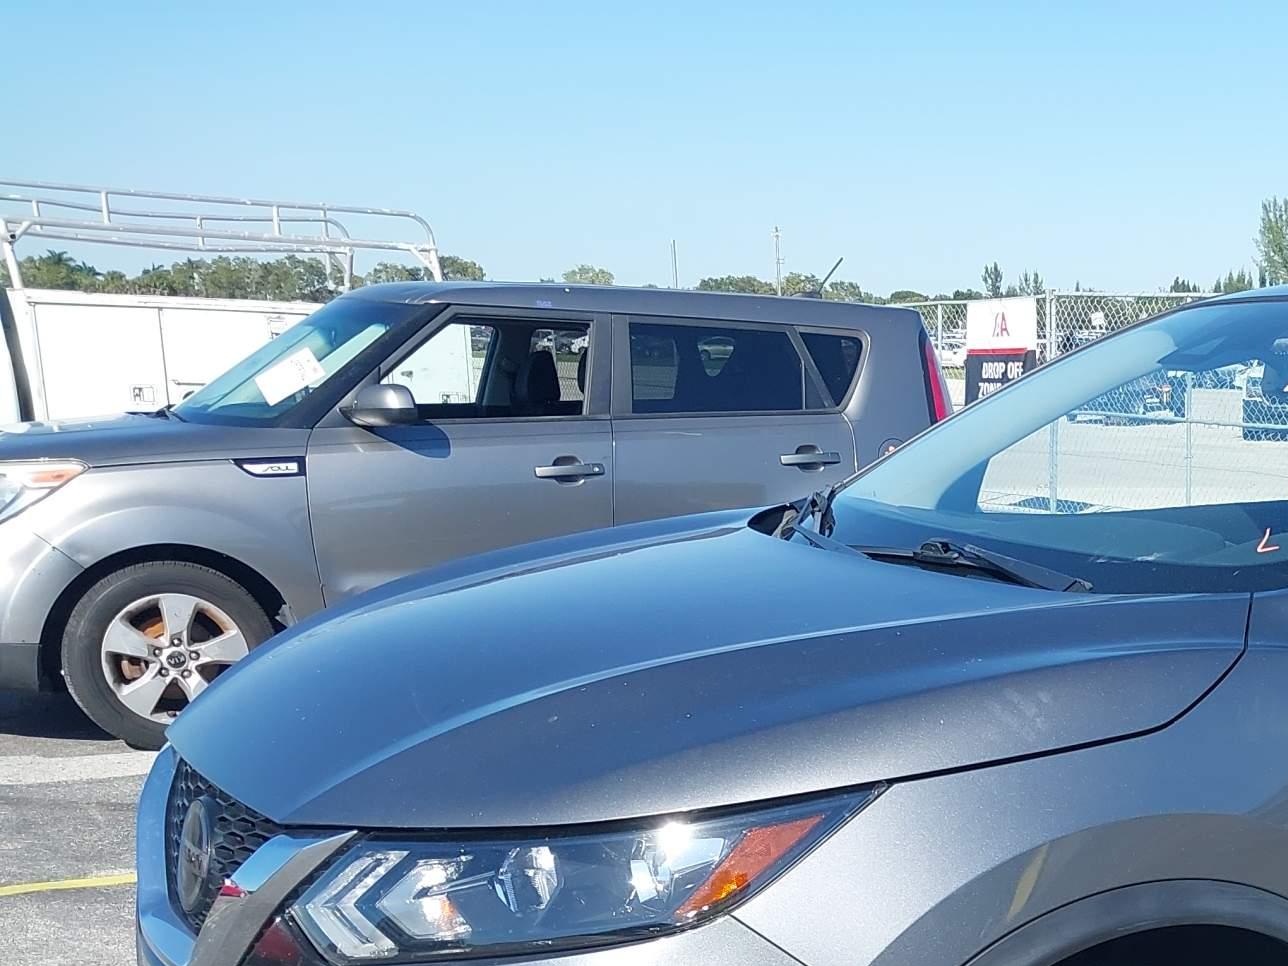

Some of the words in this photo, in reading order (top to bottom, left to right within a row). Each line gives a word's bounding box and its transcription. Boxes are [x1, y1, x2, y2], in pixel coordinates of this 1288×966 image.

[982, 362, 1005, 379] DROP
[1007, 361, 1024, 379] OFF
[168, 655, 186, 665] KIA
